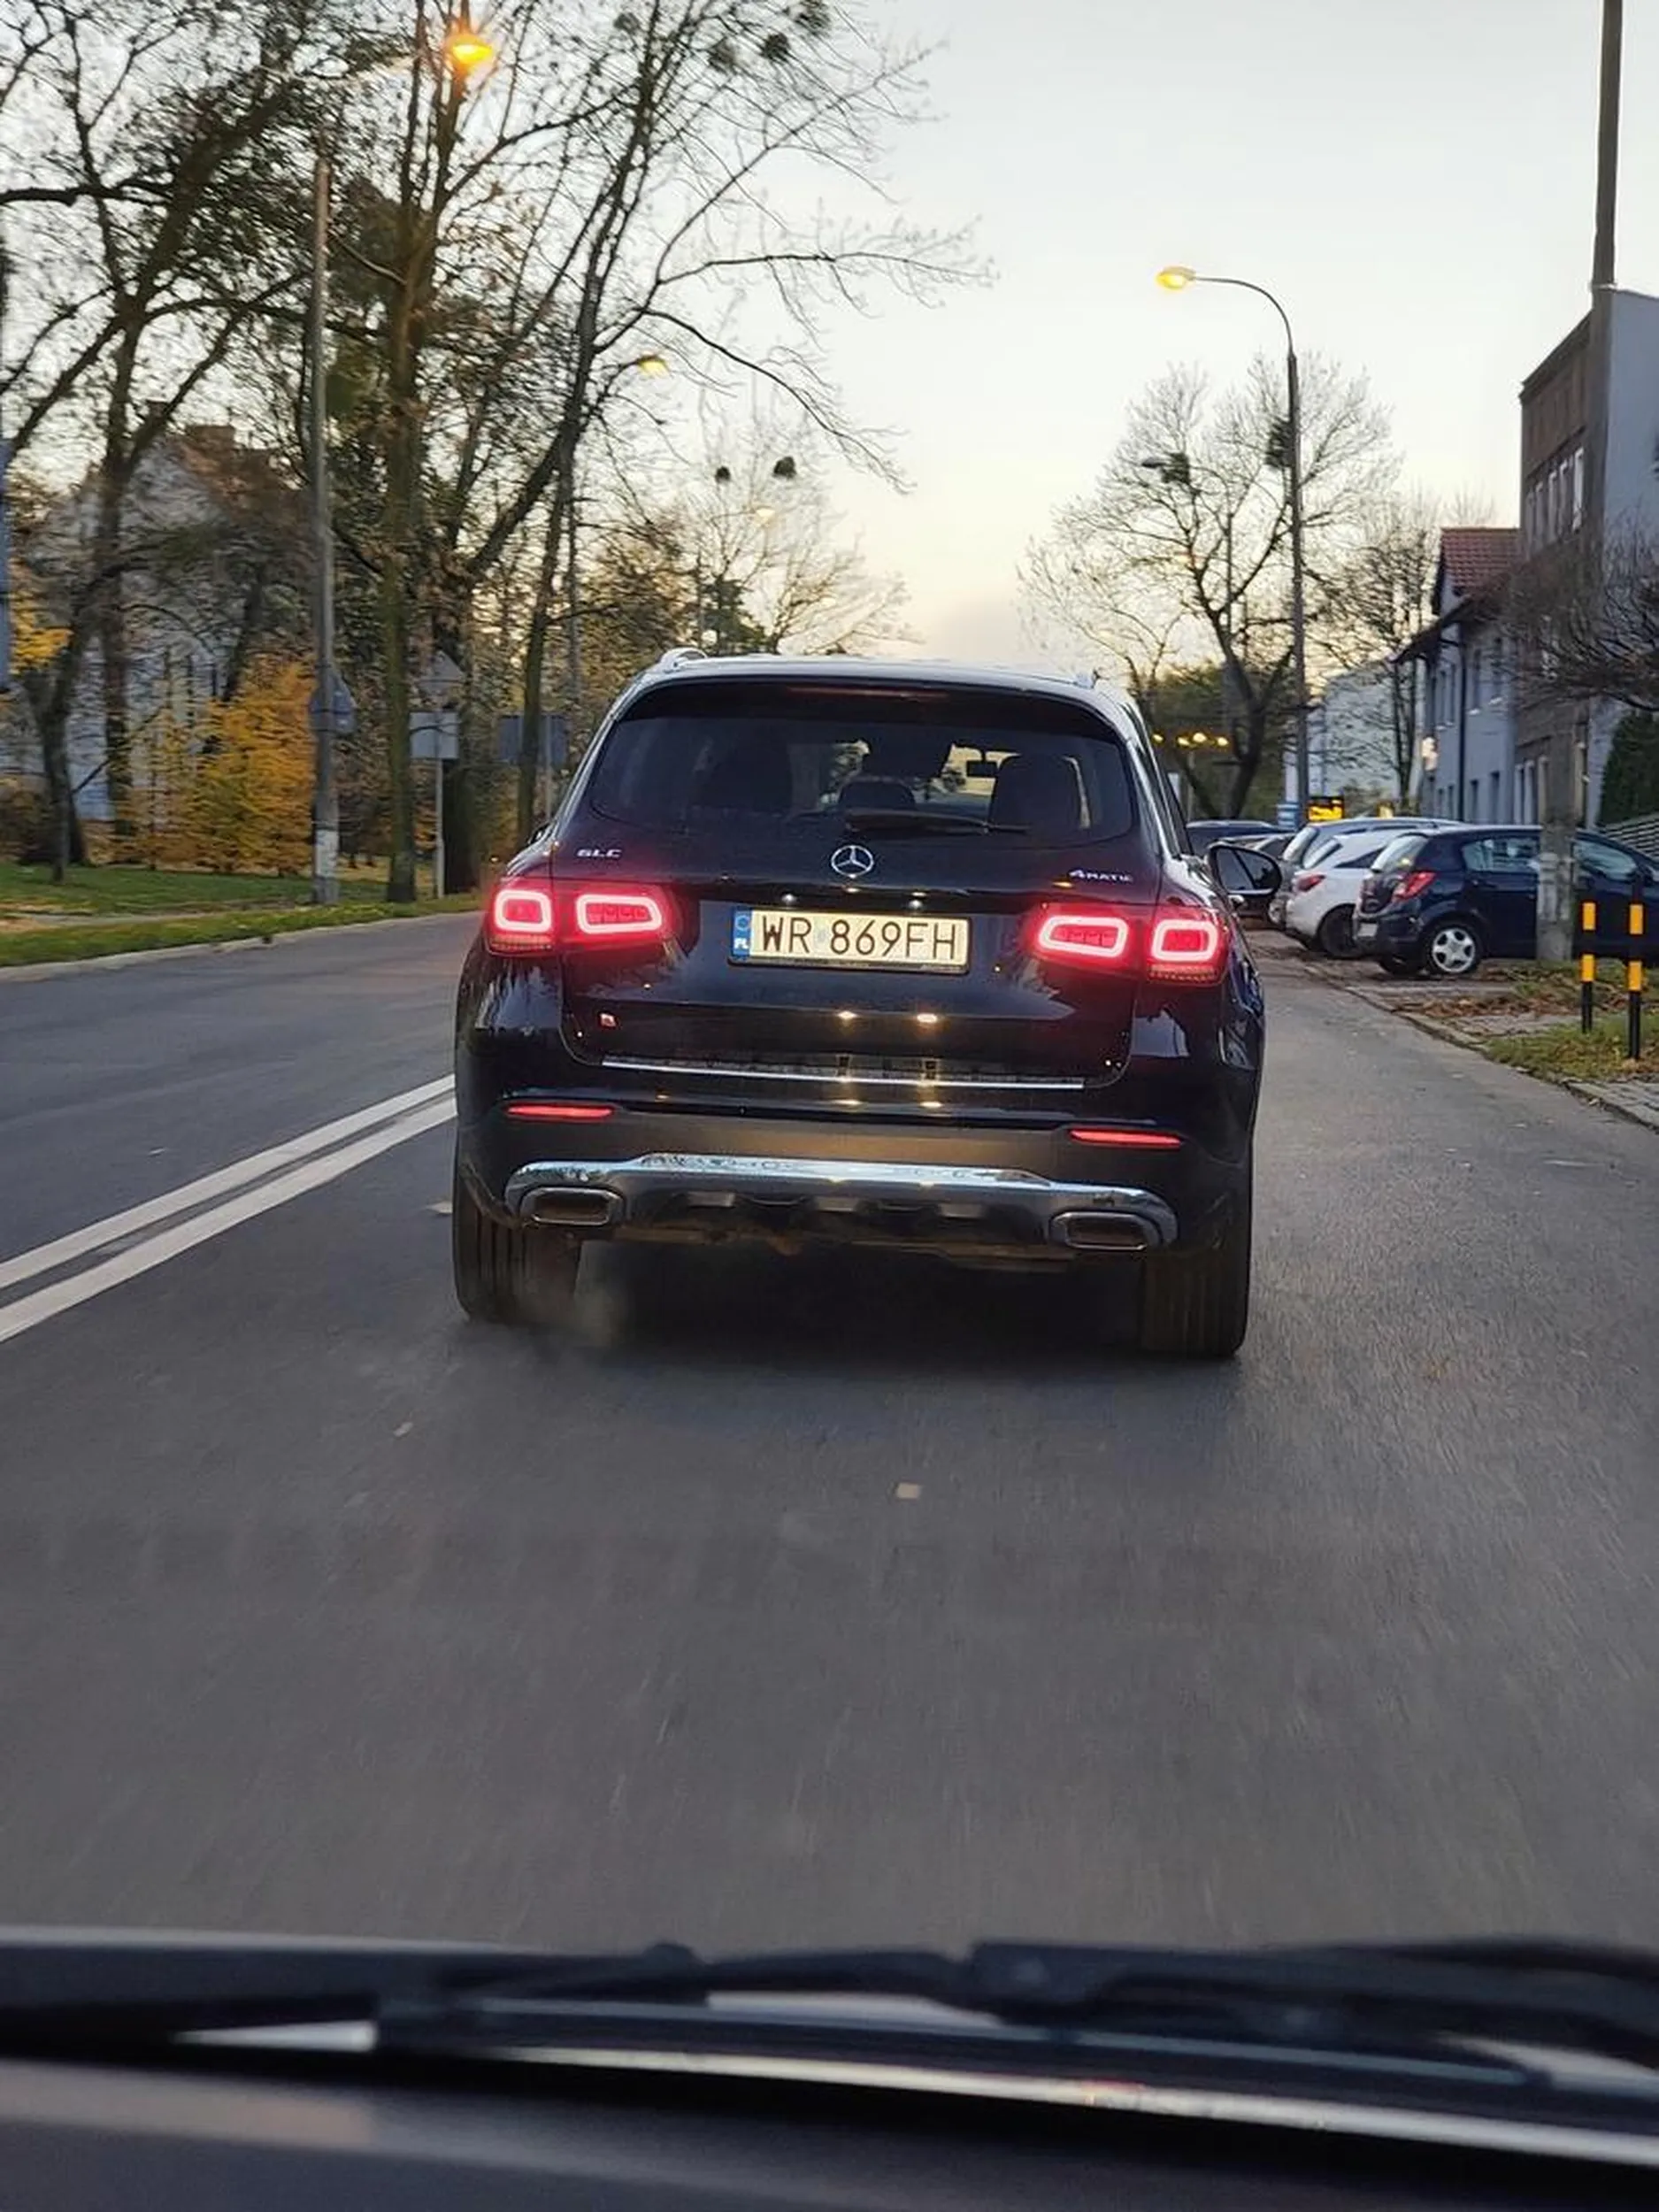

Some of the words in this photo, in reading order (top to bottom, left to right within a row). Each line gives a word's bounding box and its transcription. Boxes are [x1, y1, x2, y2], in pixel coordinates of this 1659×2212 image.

[577, 849, 622, 857] GLC
[762, 915, 811, 953] WR
[829, 918, 956, 960] 869FH
[733, 938, 749, 949] PL
